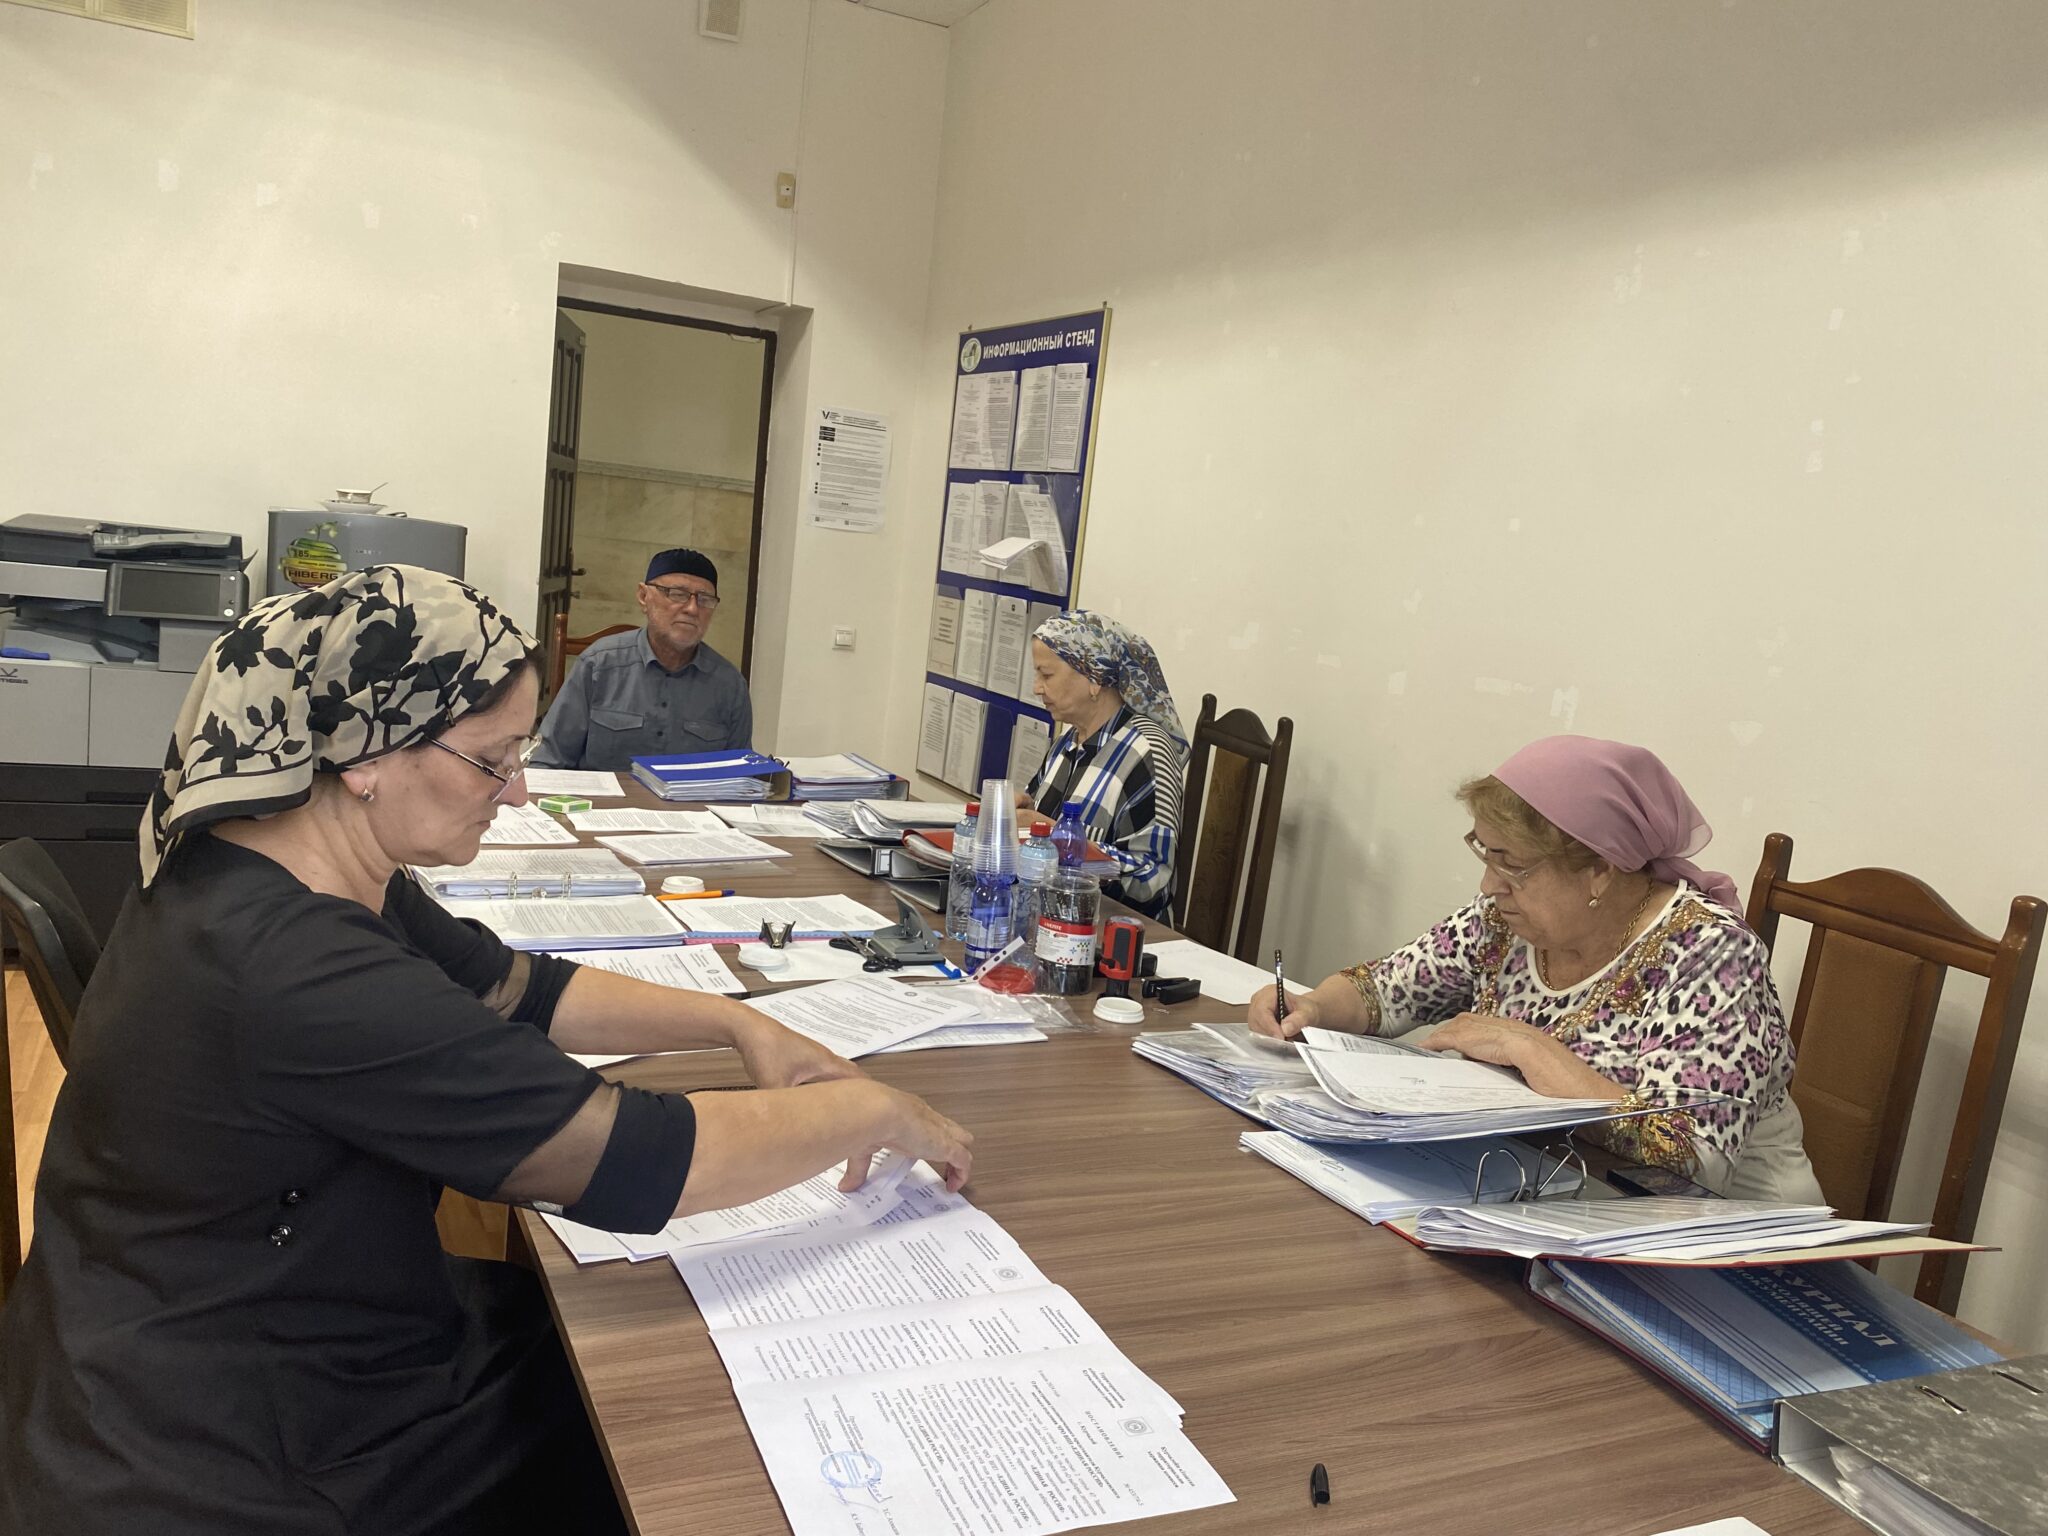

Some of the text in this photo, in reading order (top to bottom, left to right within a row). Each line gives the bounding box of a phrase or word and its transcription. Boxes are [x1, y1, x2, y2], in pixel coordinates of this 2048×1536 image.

[983, 328, 1095, 359] ИНФОРМАЦИОННЫЙ СТЕНД
[288, 568, 339, 581] HIBERG
[1760, 1277, 1844, 1331] ВХОДЯЩЕЙ
[1084, 1410, 1124, 1458] ПОСТАНОВЛЕНИЕ
